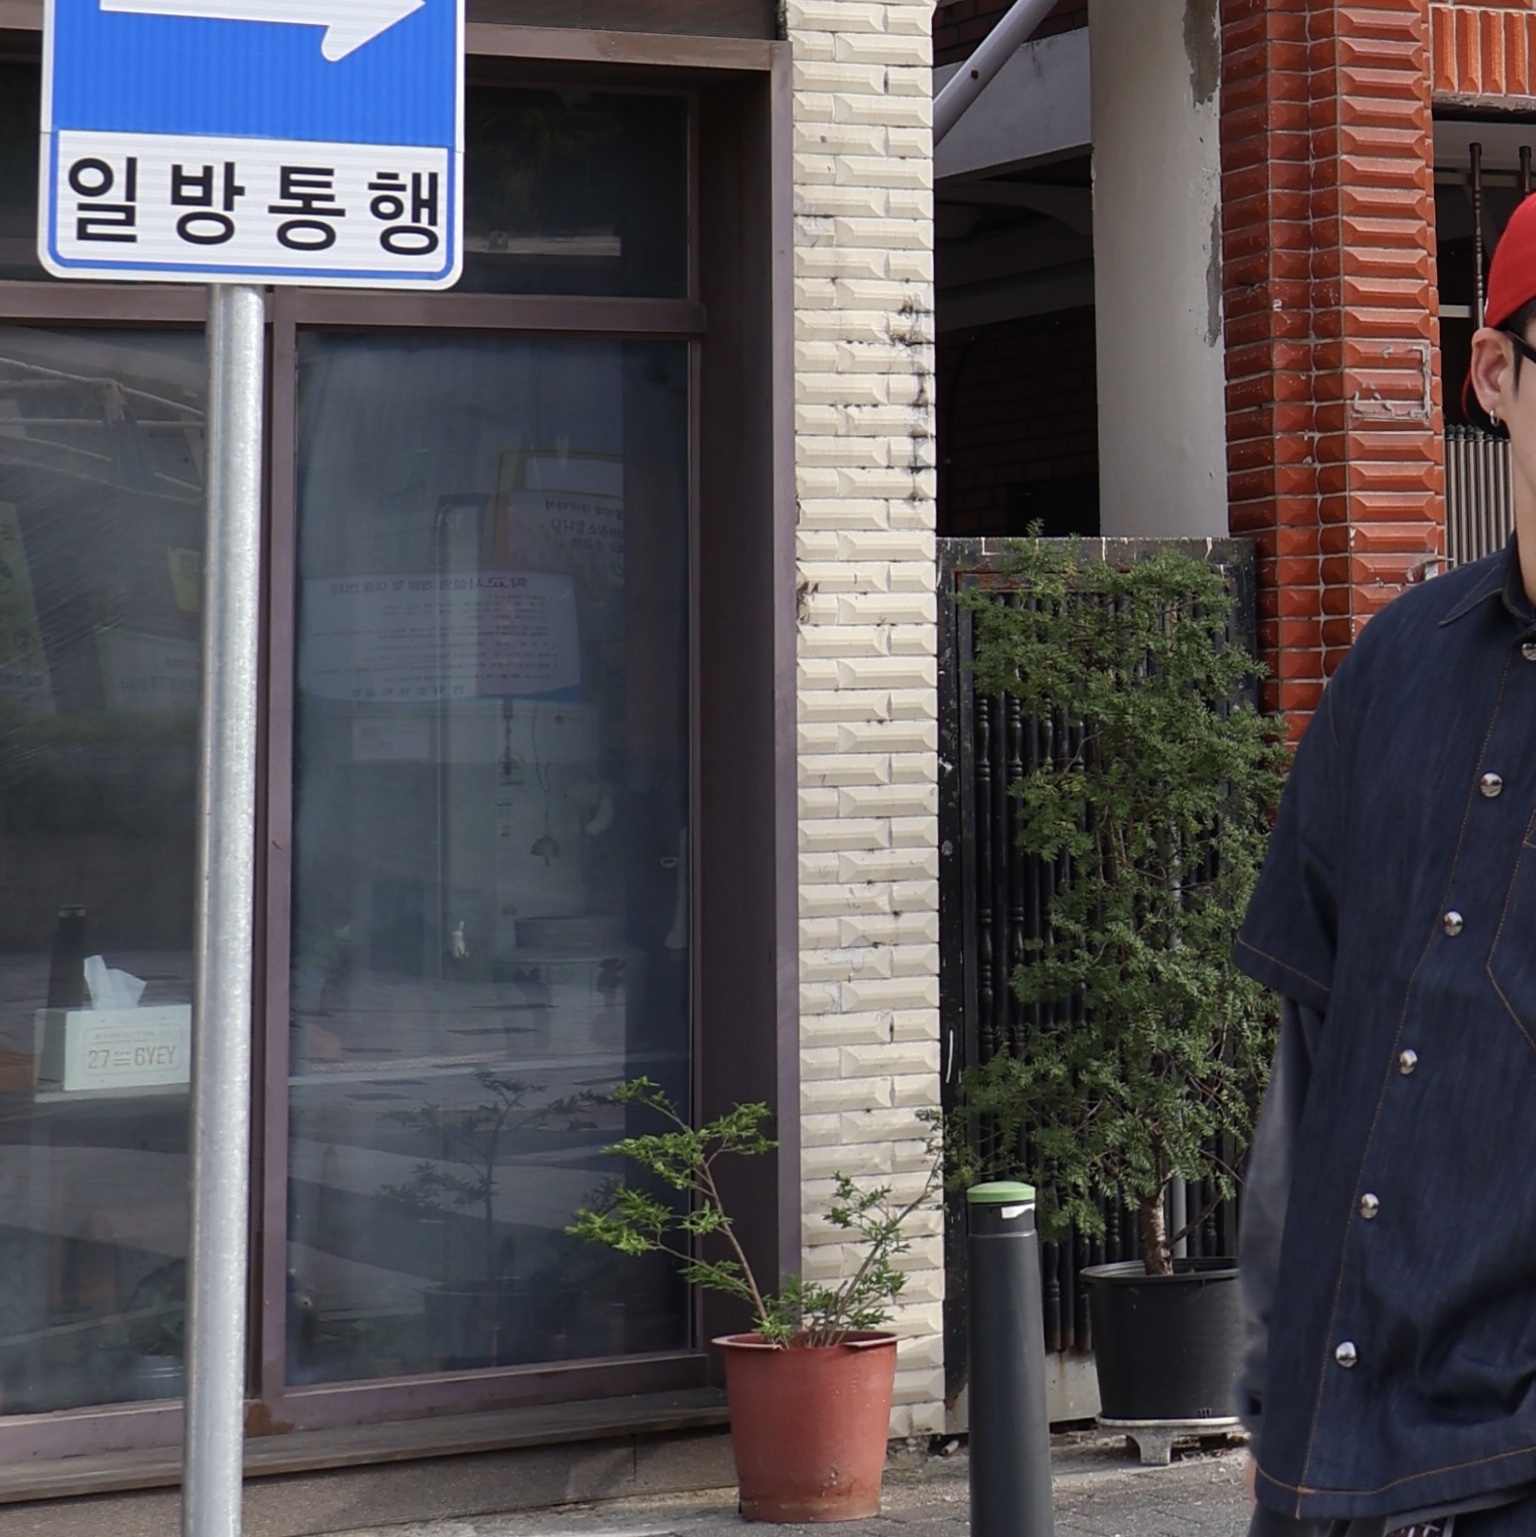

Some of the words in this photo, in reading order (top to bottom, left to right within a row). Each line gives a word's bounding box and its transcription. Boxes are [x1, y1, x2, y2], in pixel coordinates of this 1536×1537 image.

[67, 156, 440, 257] 일방통행
[88, 1049, 110, 1069] 27
[134, 1045, 177, 1067] 6YEY
